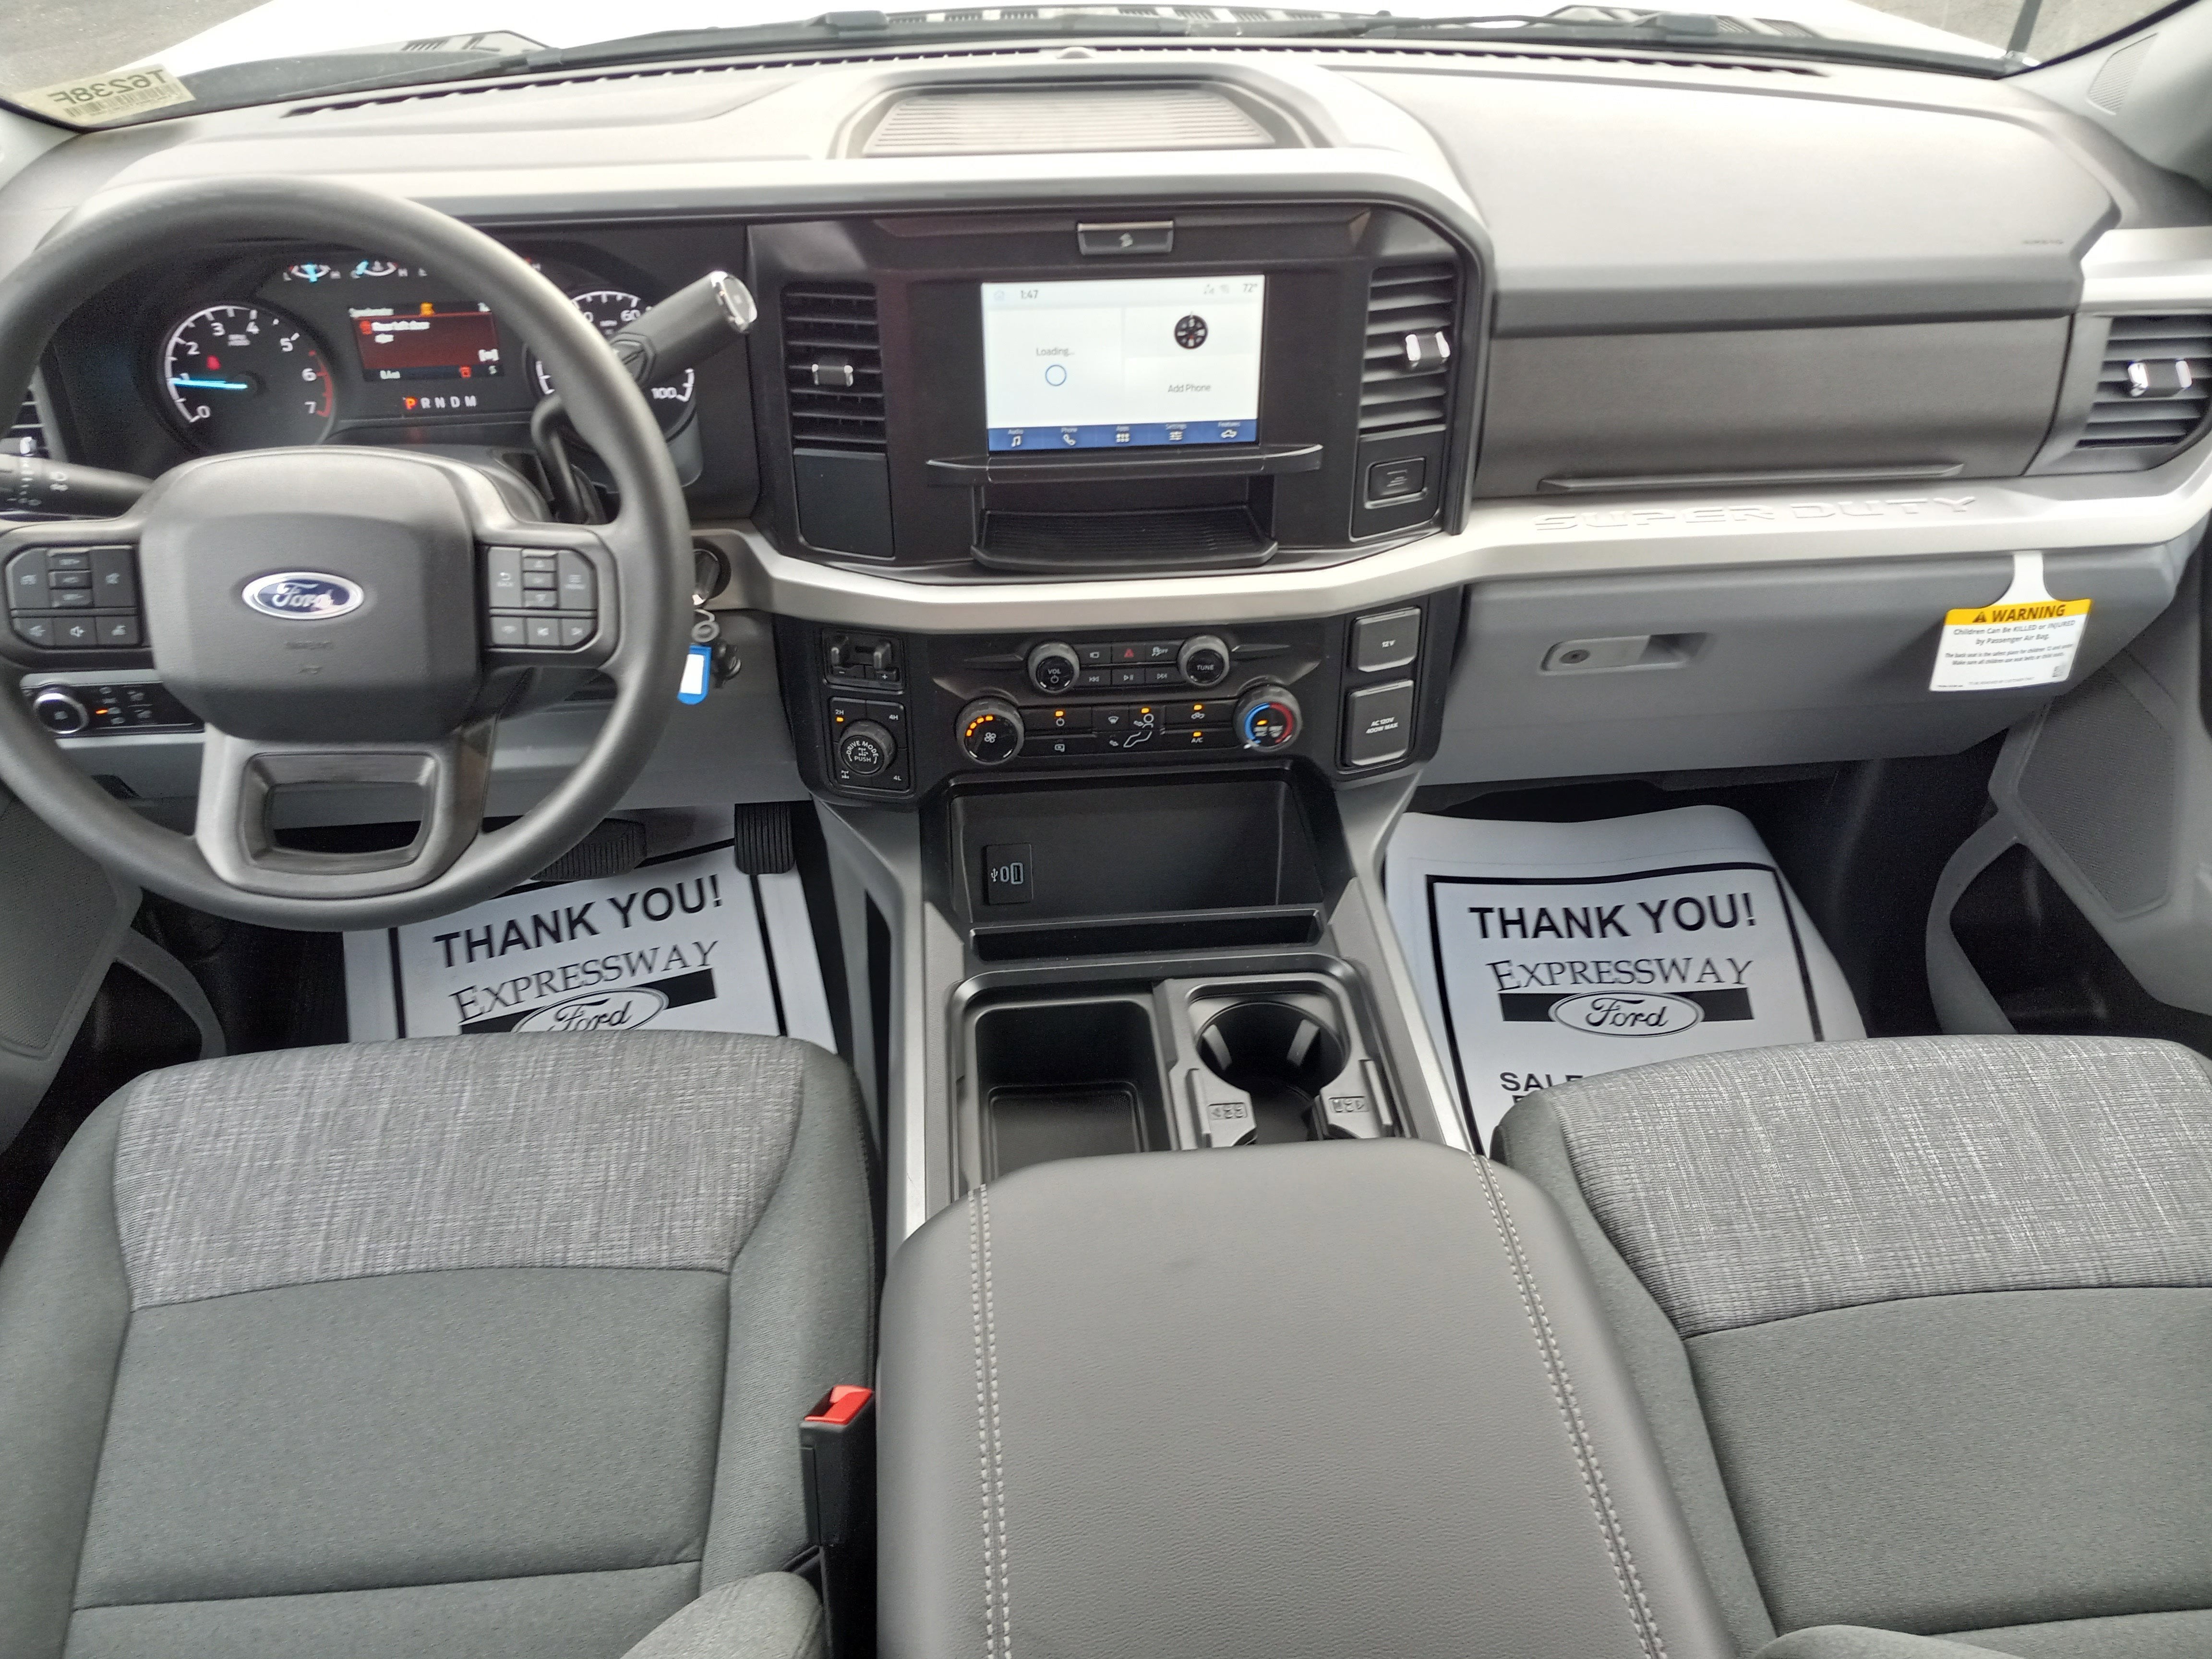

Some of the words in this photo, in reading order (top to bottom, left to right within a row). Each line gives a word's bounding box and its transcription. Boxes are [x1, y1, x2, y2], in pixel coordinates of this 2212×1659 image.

[1020, 289, 1039, 299] 1:47
[211, 322, 226, 336] 3
[247, 321, 260, 335] 4
[186, 341, 200, 355] 2
[280, 337, 293, 352] 5
[301, 368, 317, 382] 6
[650, 387, 677, 399] 100
[1167, 384, 1184, 393] Add
[1185, 384, 1211, 392] Phone
[304, 401, 317, 414] 7
[405, 396, 417, 409] P
[421, 397, 431, 409] R
[434, 397, 445, 409] N
[450, 396, 460, 408] D
[464, 395, 477, 407] M
[196, 405, 210, 418] 0
[1534, 504, 1775, 530] SUPER
[1790, 496, 1976, 518] DUTY
[272, 582, 334, 608] Ford
[1993, 604, 2066, 623] WARNING
[2047, 620, 2076, 629] INJURED
[1986, 636, 2023, 644] Passenger
[846, 740, 861, 755] DRIVE
[862, 741, 879, 757] MODE
[434, 901, 600, 969] THANK
[606, 874, 723, 929] YOU!
[1468, 903, 1631, 939] THANK
[1637, 892, 1756, 934] YOU!
[448, 940, 719, 1023] EXPRESSWAY
[1486, 957, 1755, 992] EXPRESSWAY
[546, 998, 634, 1033] Ford
[1585, 997, 1670, 1028] Ford
